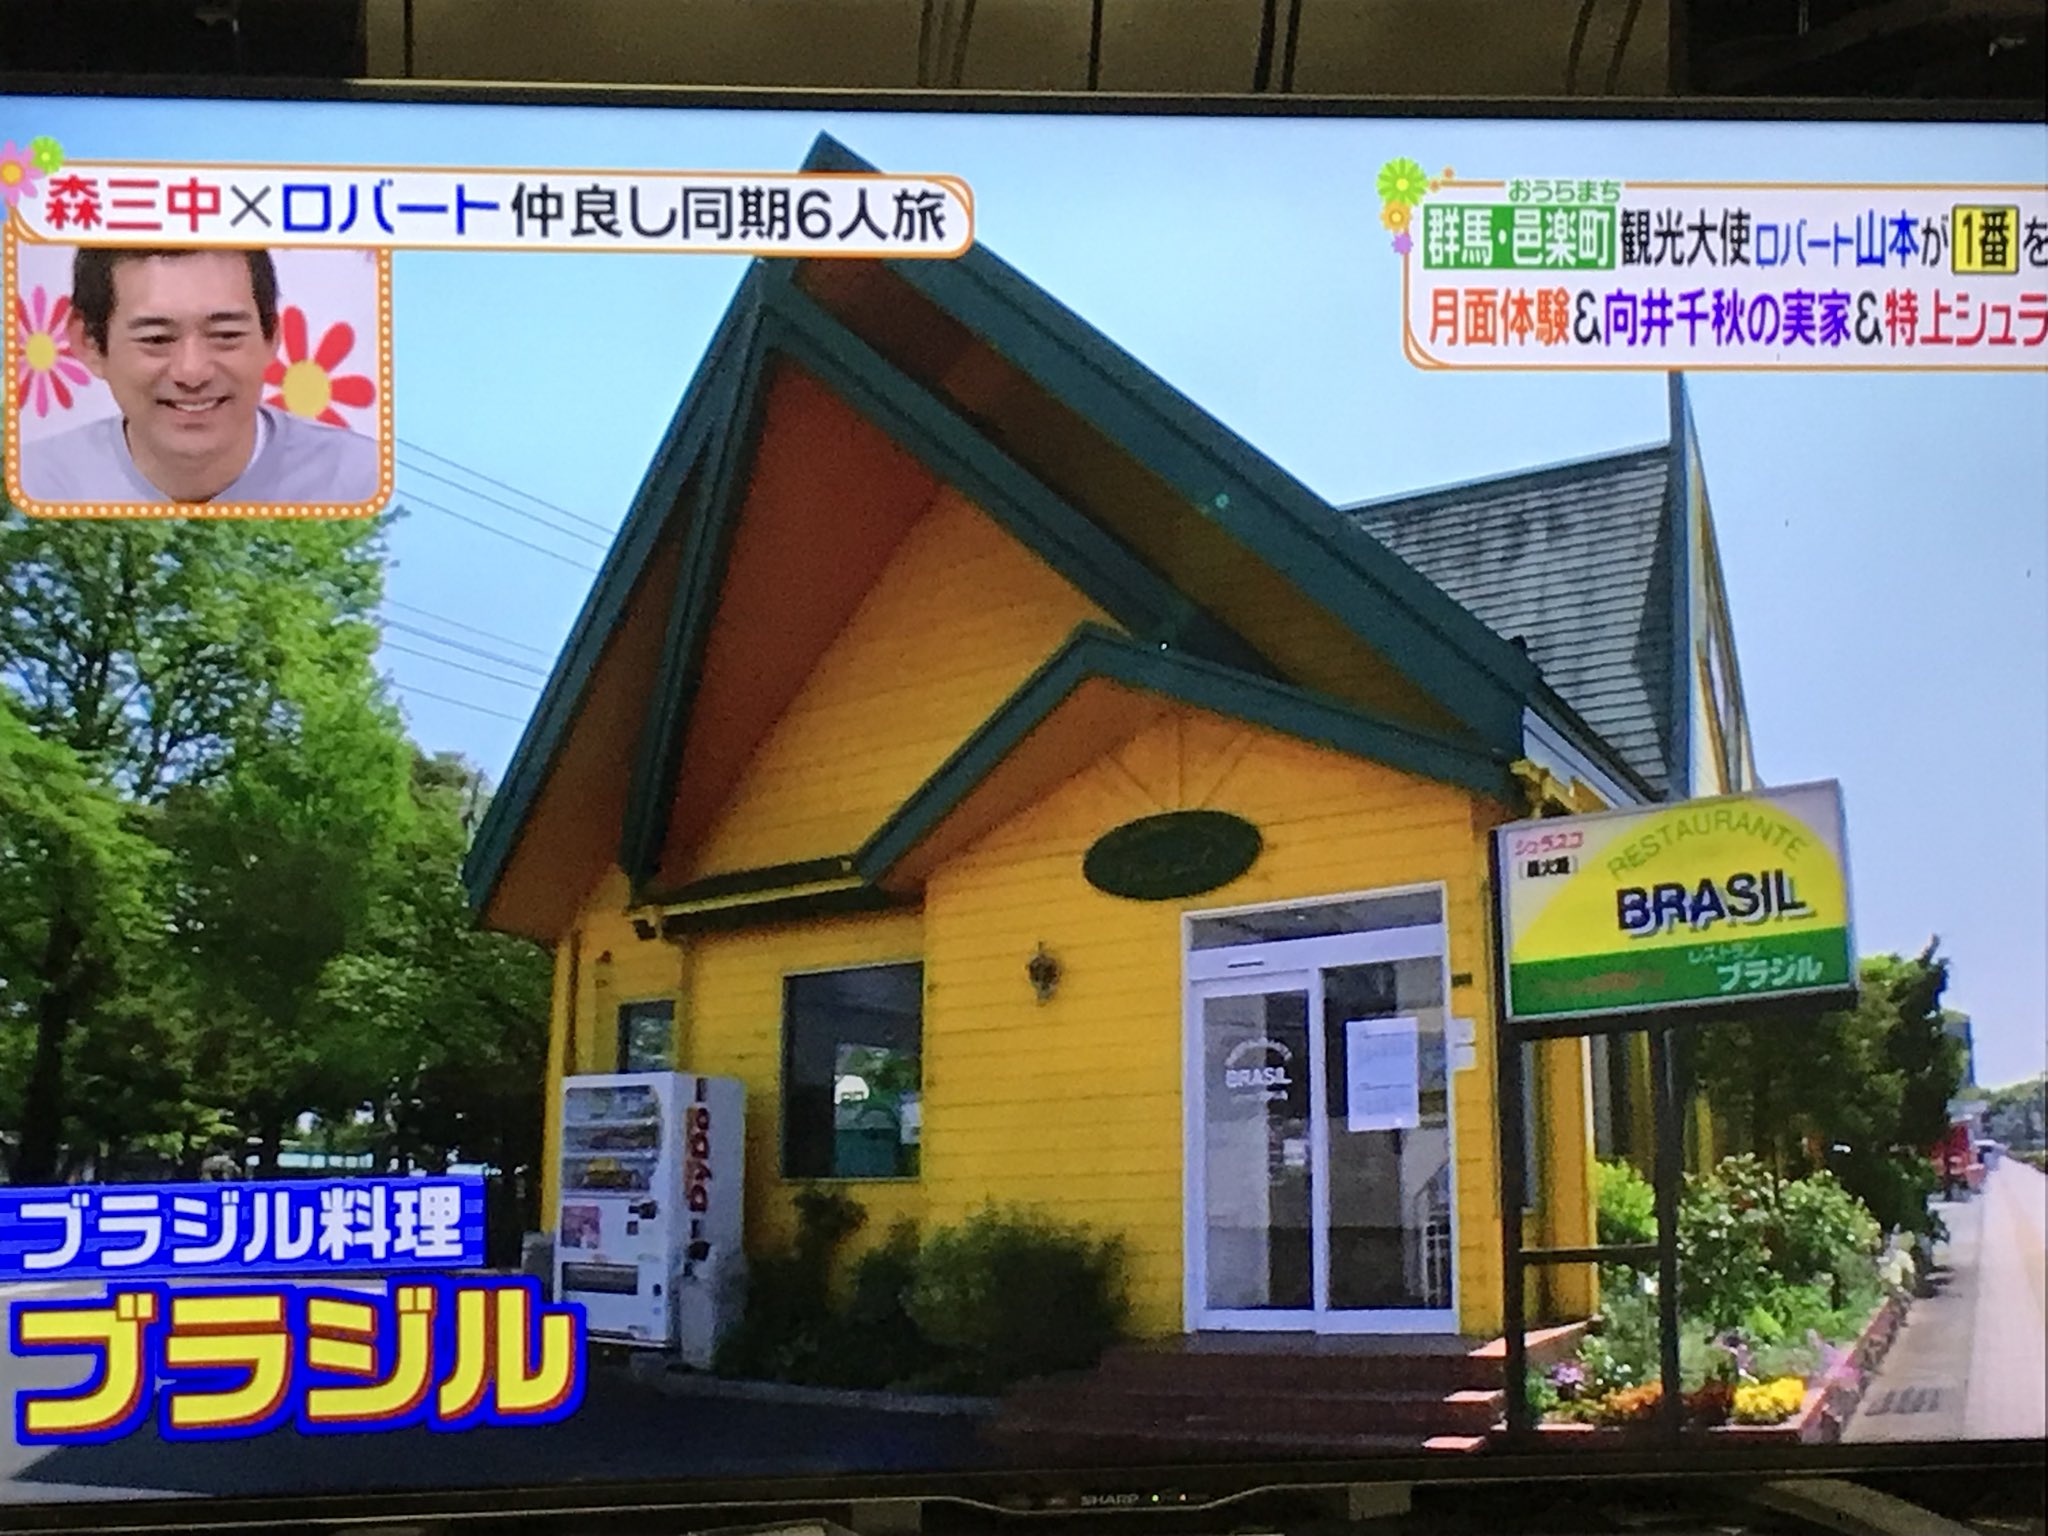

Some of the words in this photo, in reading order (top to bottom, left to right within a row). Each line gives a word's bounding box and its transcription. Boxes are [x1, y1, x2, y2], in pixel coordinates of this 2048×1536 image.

[1508, 179, 1622, 203] おうらまち
[1607, 809, 1807, 878] RESTAURANTE
[1616, 869, 1816, 937] BRASIL
[1717, 956, 1823, 991] ブラジル
[20, 1186, 463, 1269] ブラジル料理
[20, 1287, 577, 1434] ブラジル
[1080, 1493, 1140, 1506] SHARP
